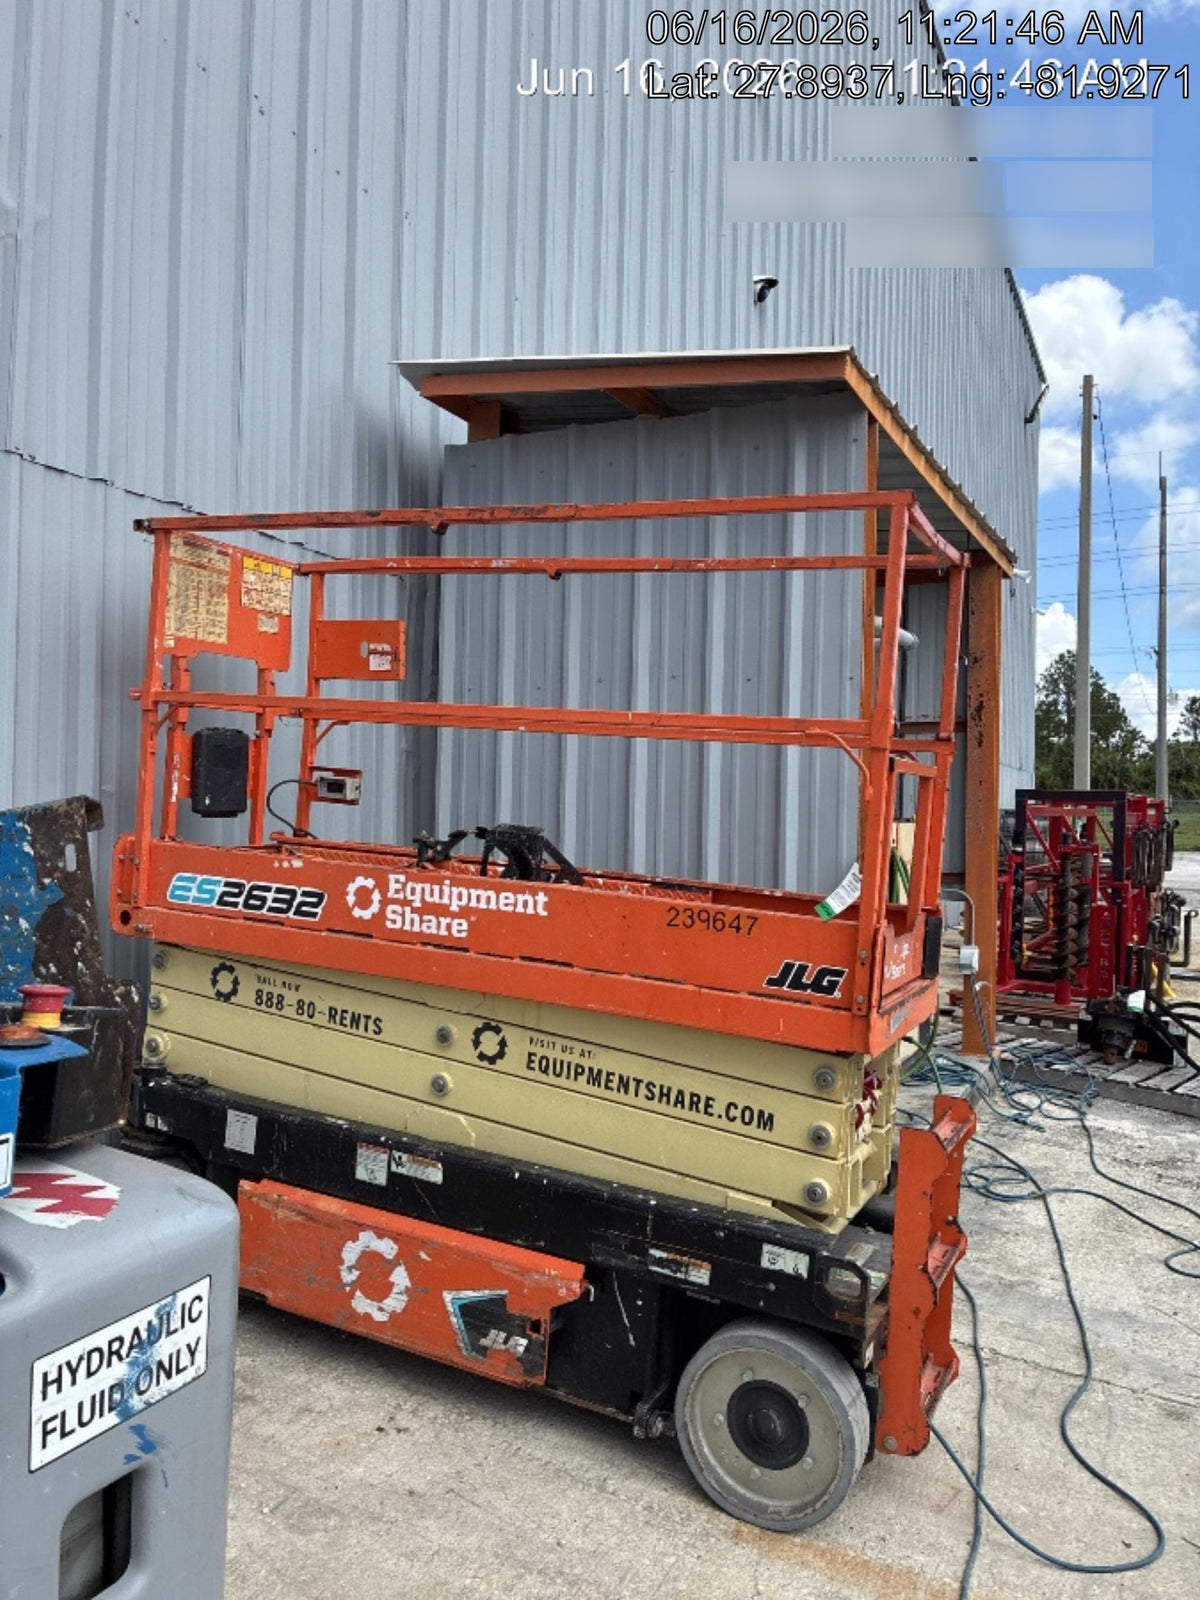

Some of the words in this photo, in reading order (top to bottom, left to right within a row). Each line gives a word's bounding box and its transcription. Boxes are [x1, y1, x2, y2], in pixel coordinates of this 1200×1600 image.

[167, 872, 328, 921] ES2632
[387, 874, 548, 917] Equipment
[385, 904, 469, 938] Share
[666, 906, 759, 936] 239647
[763, 959, 848, 998] JLG
[254, 988, 383, 1036] 888-80-RENTS
[526, 1051, 775, 1133] EQUIPMENTSHARE.COM
[41, 1295, 203, 1402] HYDRAULIC
[42, 1381, 125, 1451] FLUID
[135, 1336, 201, 1397] ONLY
